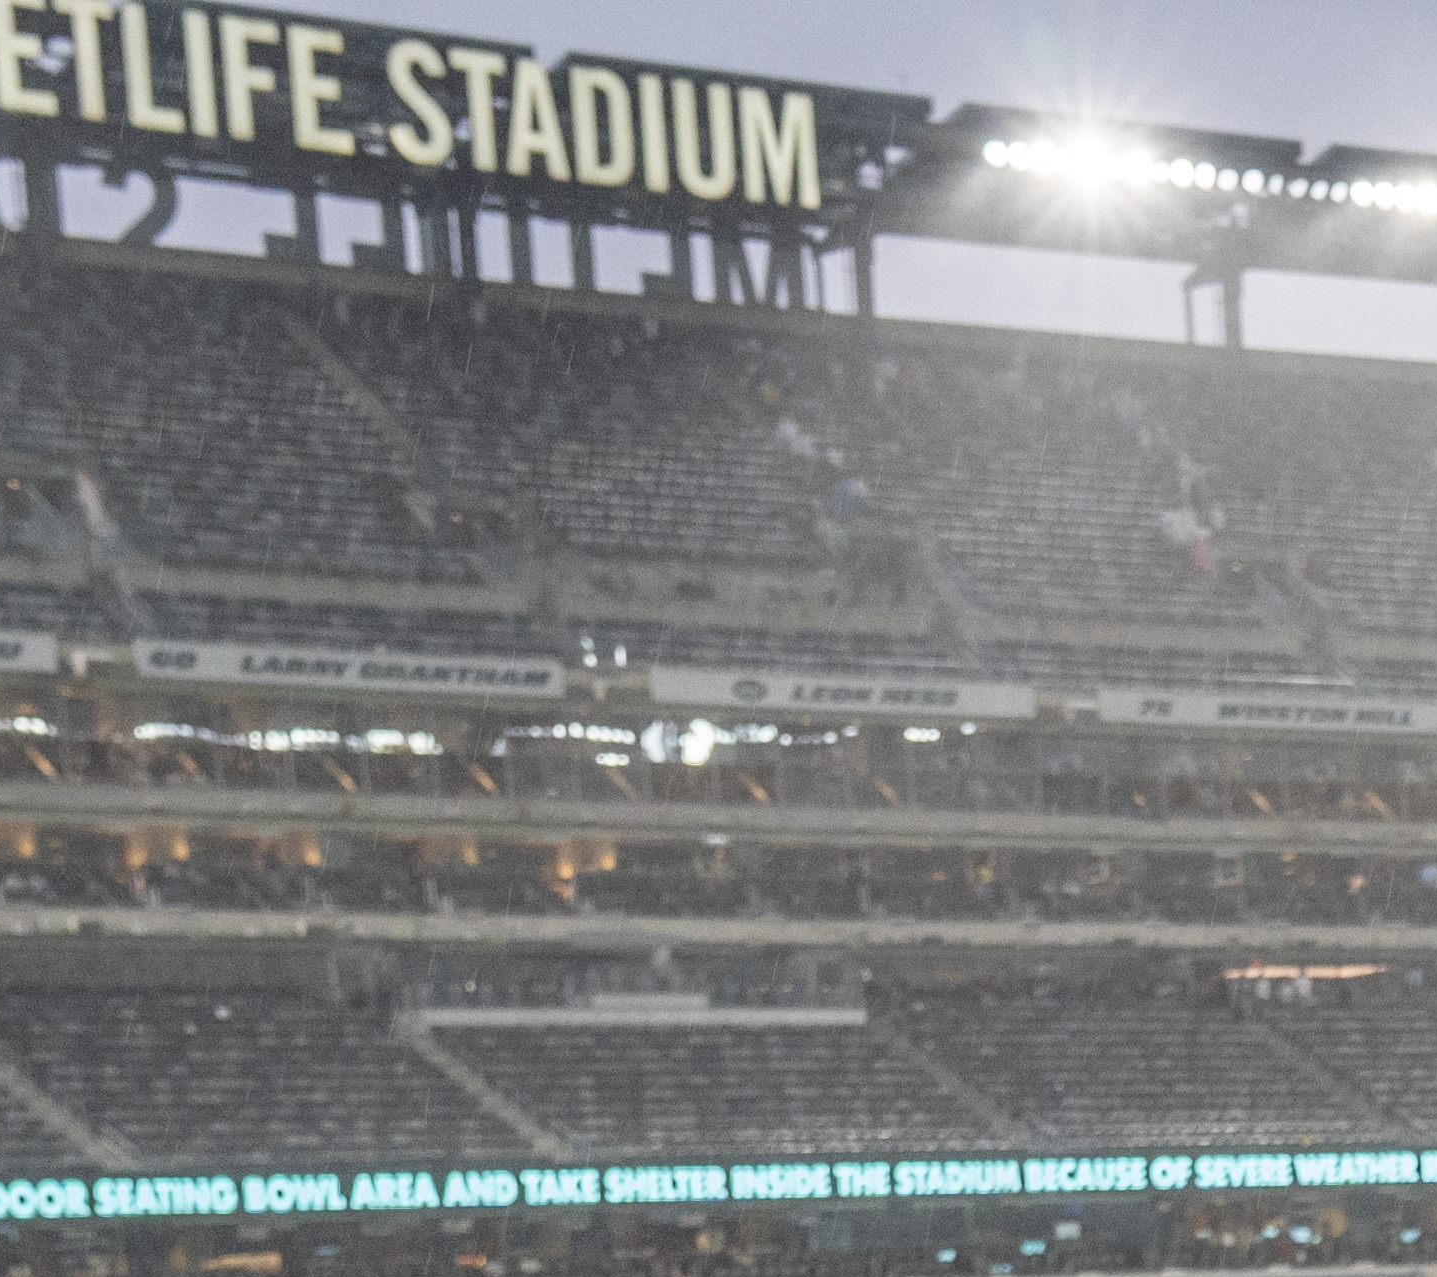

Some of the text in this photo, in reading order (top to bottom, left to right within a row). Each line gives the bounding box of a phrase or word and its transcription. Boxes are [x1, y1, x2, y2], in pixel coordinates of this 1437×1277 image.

[385, 38, 823, 210] STADIUM
[93, 1175, 238, 1219] SEATING
[242, 1173, 347, 1214] BOWL
[350, 1171, 440, 1211] AREA
[443, 1169, 518, 1209] AND
[520, 1168, 601, 1207] TAKE
[604, 1165, 729, 1205] SHELTER
[730, 1163, 832, 1201] INSIDE
[833, 1161, 891, 1198] THE
[893, 1159, 1022, 1197] STADIUM
[1023, 1156, 1148, 1194] BECAUSE
[1150, 1155, 1193, 1191] OF
[1194, 1153, 1293, 1190] SEVERE
[1294, 1151, 1420, 1187] WEATHER
